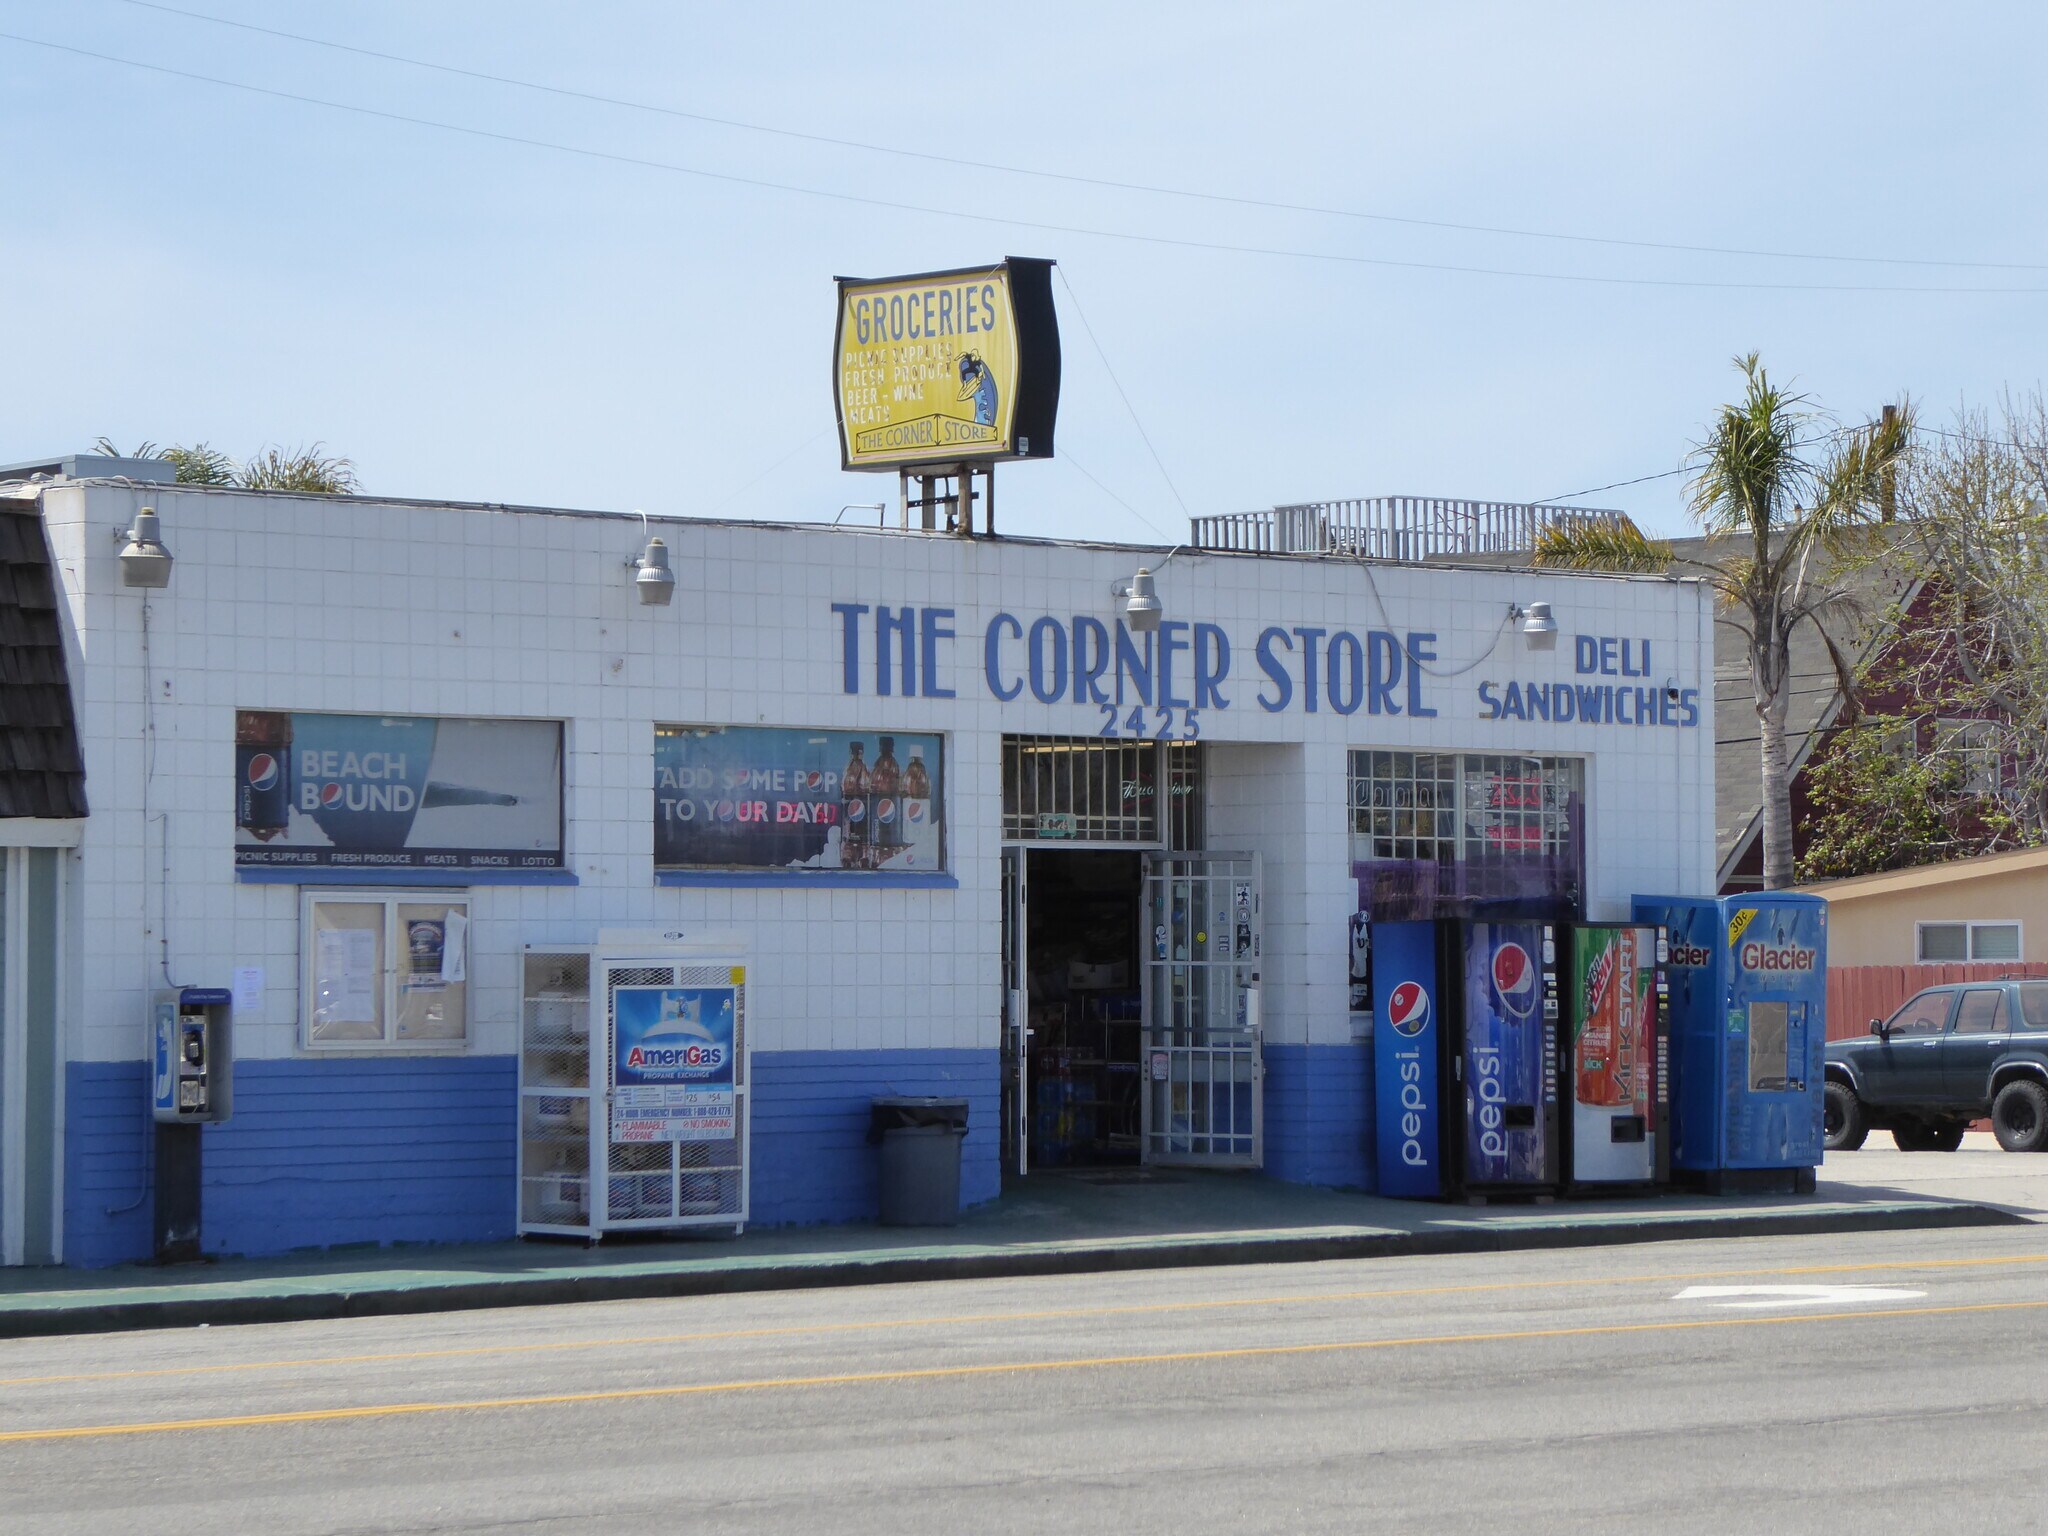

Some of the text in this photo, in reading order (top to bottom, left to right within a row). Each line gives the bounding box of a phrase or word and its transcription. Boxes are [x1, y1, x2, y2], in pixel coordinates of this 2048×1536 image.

[856, 284, 996, 345] GROCERIES
[846, 342, 952, 368] PICNIC SUPPLIES
[845, 361, 952, 388] FRESH PRODUCE
[847, 388, 877, 406] BEER
[893, 384, 924, 402] WINE
[850, 405, 890, 424] MEATS
[861, 420, 988, 449] THE CORNER STORE
[831, 603, 1438, 717] THE CORNER STORE
[1575, 634, 1651, 677] DELI
[1478, 680, 1699, 727] SANDWICHES
[1100, 703, 1200, 740] 2425
[301, 750, 406, 780] BEACH
[659, 767, 714, 789] ADD
[1122, 780, 1194, 799] Budiser
[1355, 781, 1431, 808] Corona
[660, 798, 696, 821] TO
[776, 801, 829, 824] DAY!
[235, 852, 555, 867] PICNIC SUPPLIES FRESH PRODUCE MEATS SNACKS LOTTO
[1730, 911, 1748, 934] 30¢
[1742, 943, 1816, 970] Glacier
[627, 1045, 722, 1069] AmeriGas
[643, 1071, 710, 1080] PROPANE EXCHANGE
[1395, 1052, 1427, 1166] pepsi
[1473, 1047, 1507, 1157] pepsi
[621, 1121, 667, 1131] FLAMMABLE
[621, 1131, 654, 1140] PROPANE
[690, 1119, 731, 1129] NO SMOKING
